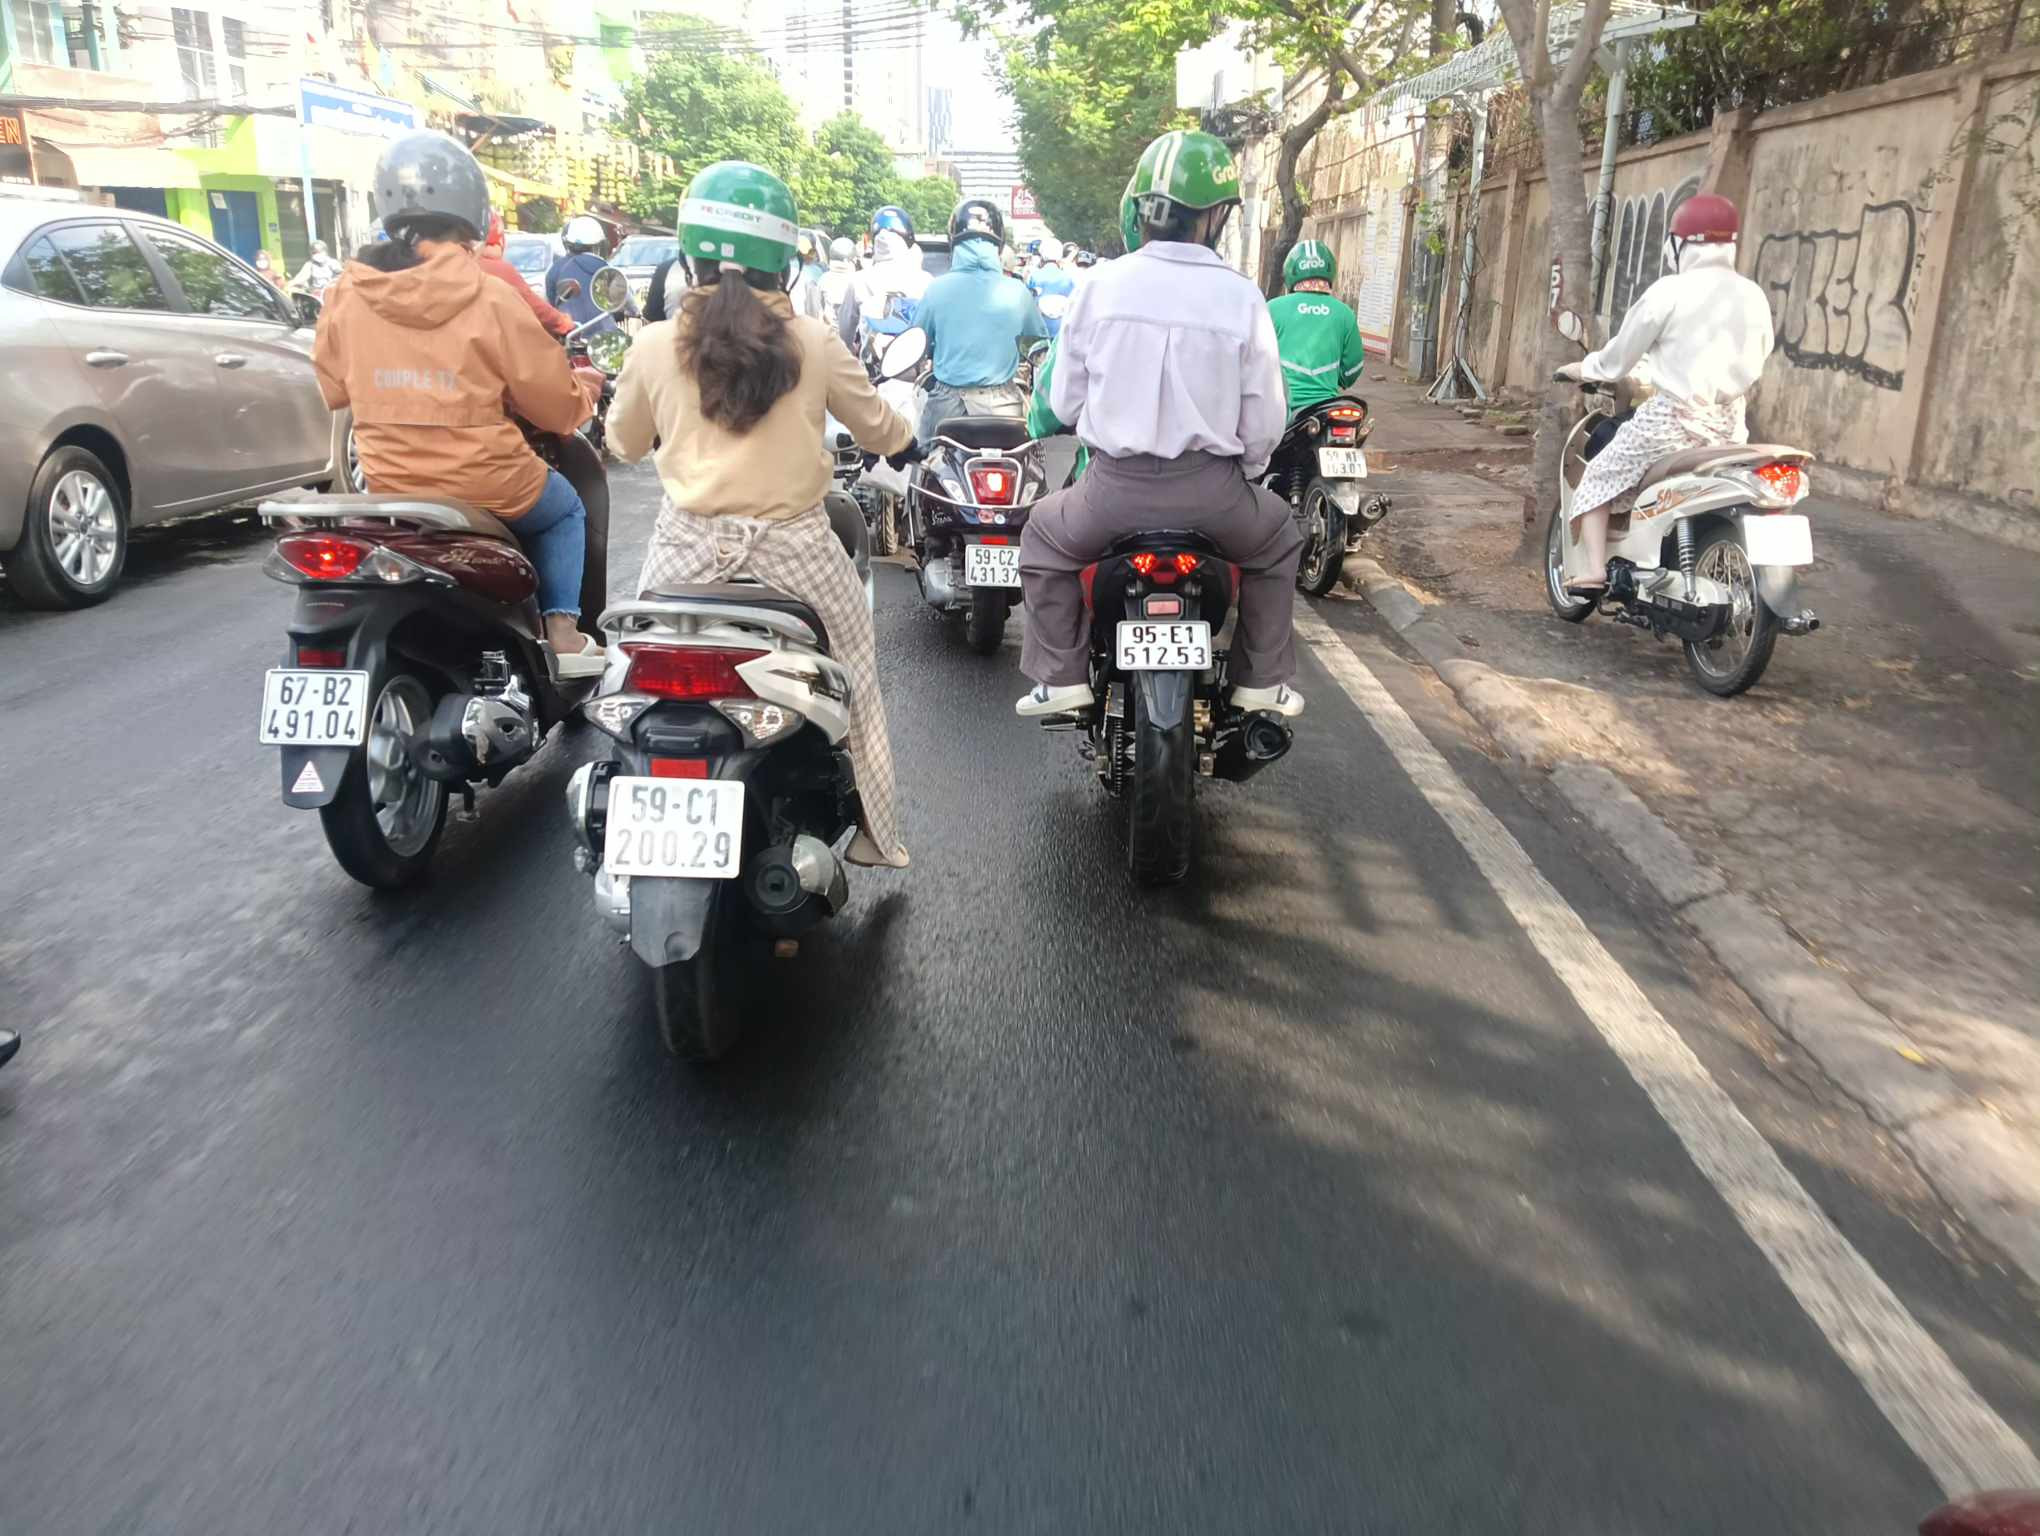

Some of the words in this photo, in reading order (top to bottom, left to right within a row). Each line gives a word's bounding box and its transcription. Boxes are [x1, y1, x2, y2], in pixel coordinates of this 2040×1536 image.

[715, 207, 761, 223] CREDIT
[1299, 255, 1325, 270] Grab
[1297, 303, 1330, 316] Grab
[975, 549, 1015, 566] 59-C2
[970, 566, 1019, 584] 431.37
[1132, 625, 1194, 644] 95-E1
[1123, 646, 1206, 666] 512.53
[280, 676, 352, 706] 67-B2
[267, 709, 356, 740] 491.04
[631, 785, 718, 825] 59-C1
[615, 828, 731, 868] 200.29
